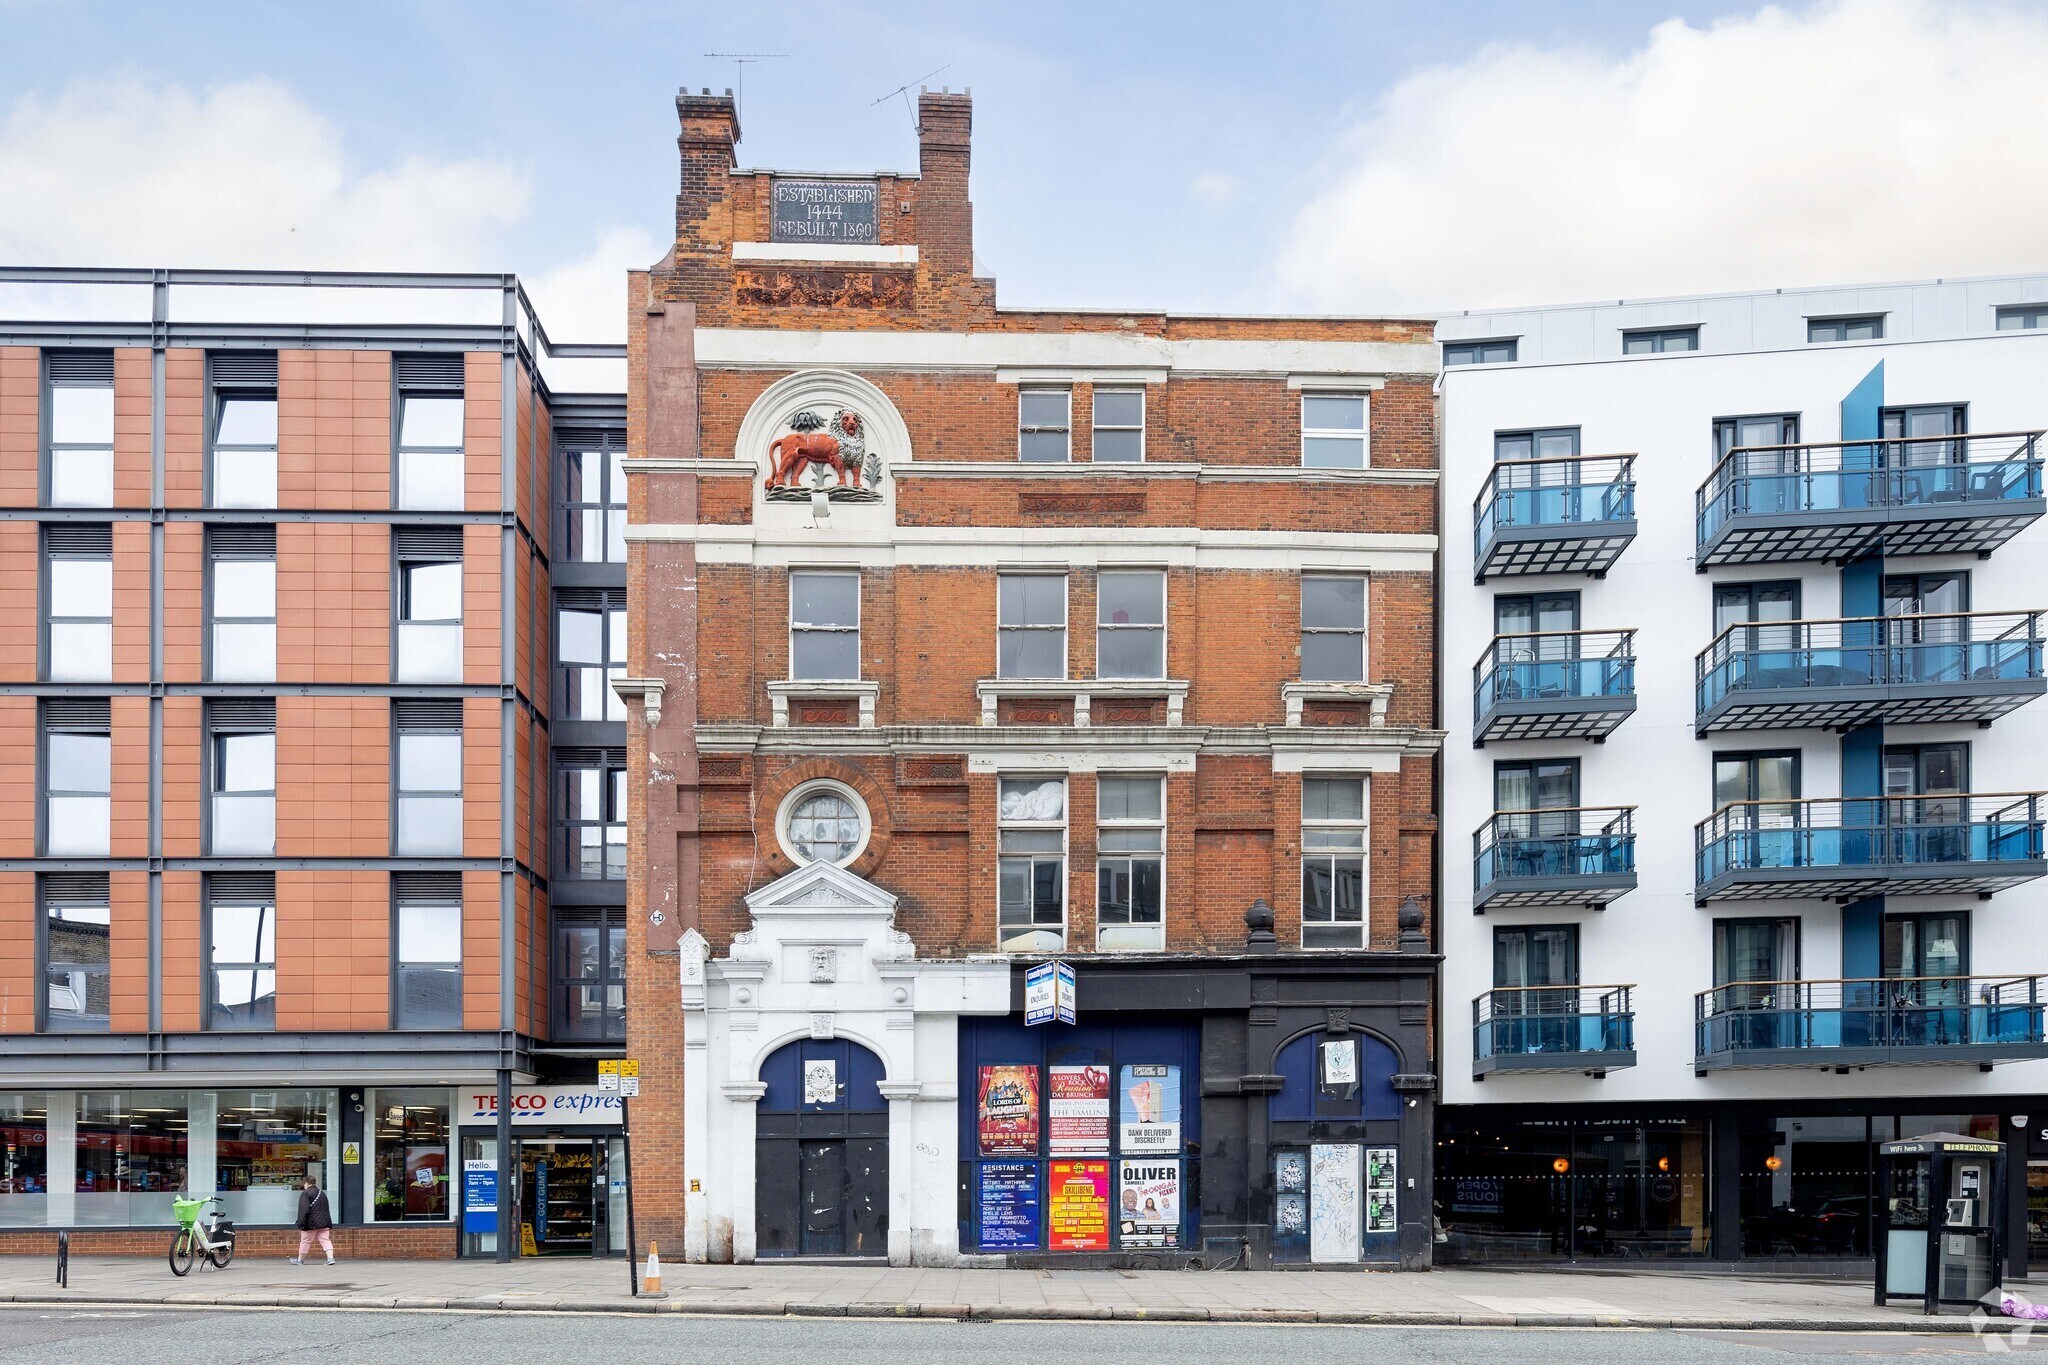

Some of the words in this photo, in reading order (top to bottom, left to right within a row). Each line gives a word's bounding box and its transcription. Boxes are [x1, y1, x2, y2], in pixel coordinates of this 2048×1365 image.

[778, 187, 872, 205] ESTABLISHED
[807, 204, 843, 220] 1444
[778, 221, 838, 236] REBUILT
[843, 222, 872, 241] 1890
[1051, 1081, 1092, 1092] Reunion
[987, 1105, 1030, 1115] LAUGHTER
[1950, 1144, 1995, 1152] TELEPHONE
[1123, 1167, 1176, 1180] OLIVER
[538, 1171, 546, 1196] GUM?
[1139, 1180, 1177, 1197] PRODIGAL
